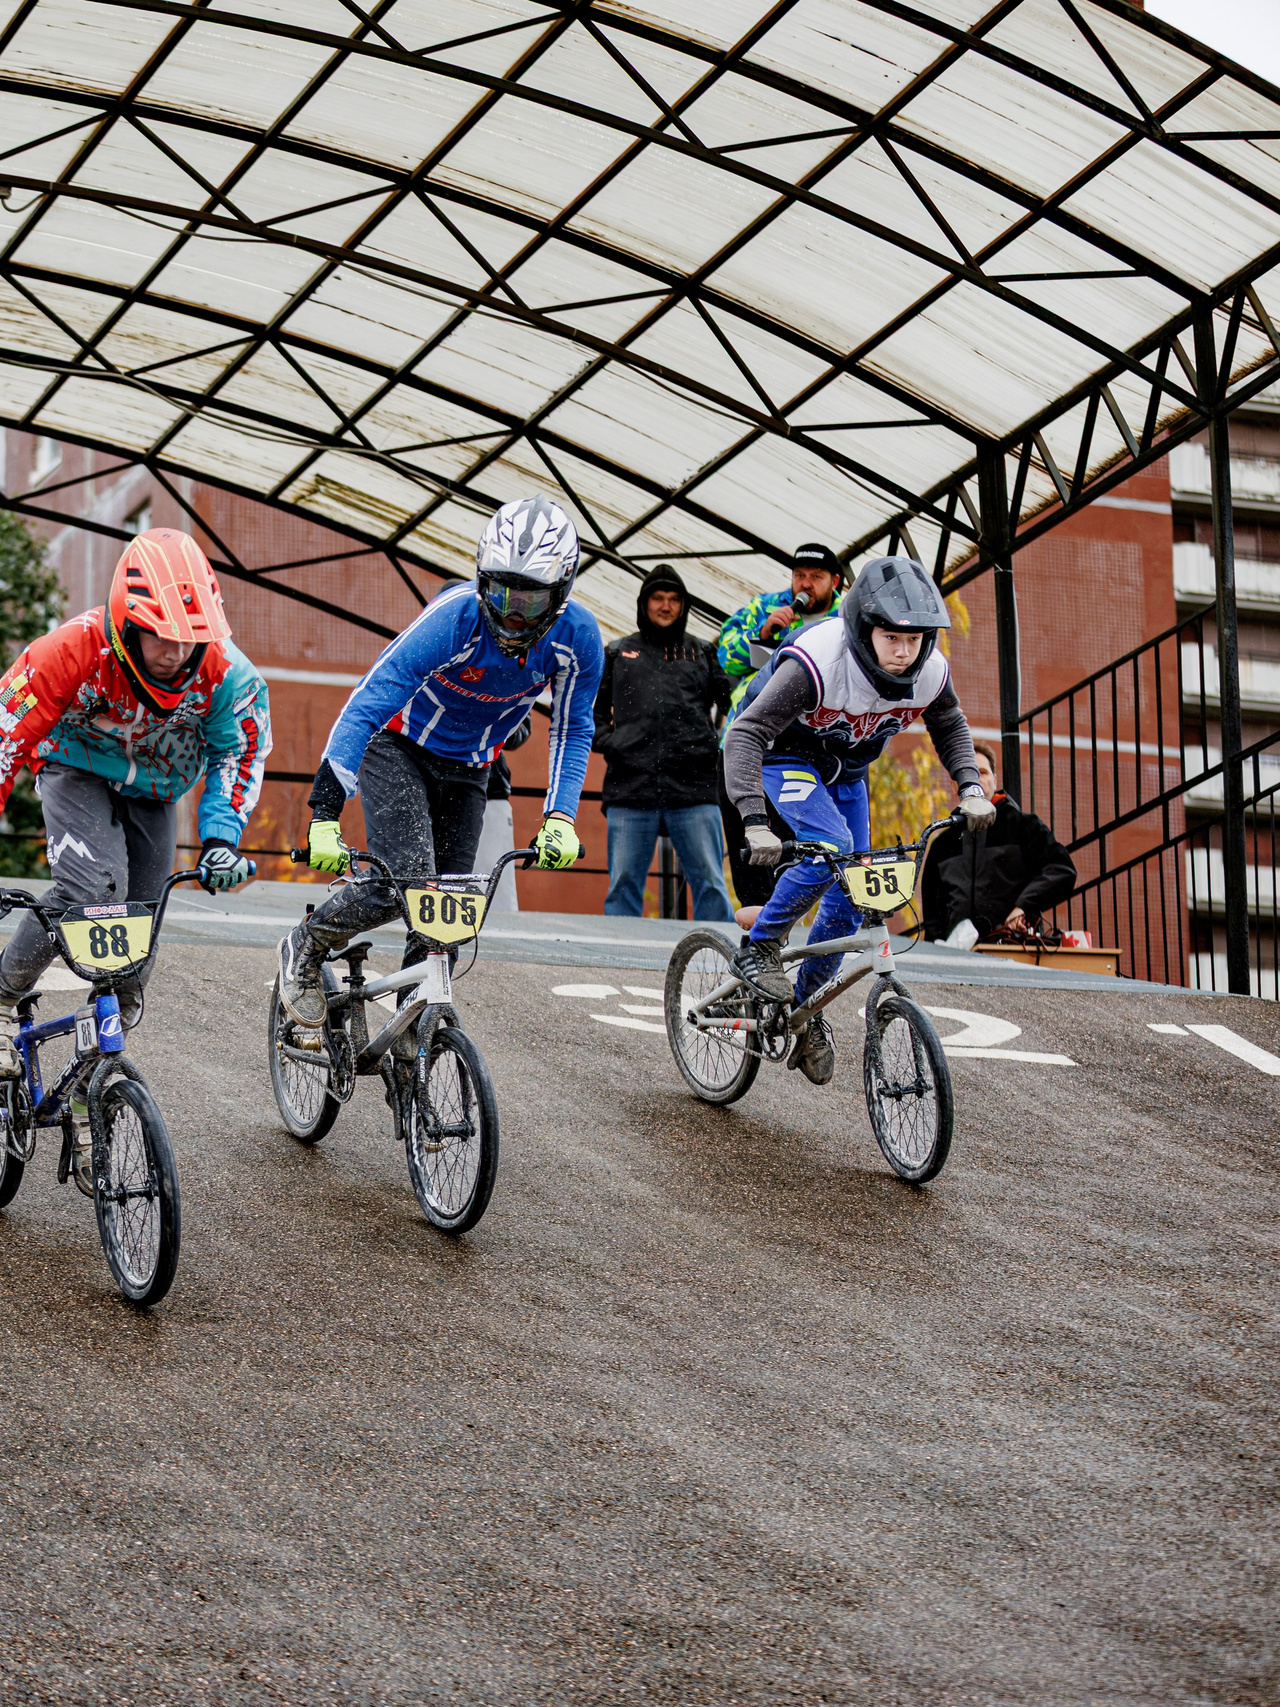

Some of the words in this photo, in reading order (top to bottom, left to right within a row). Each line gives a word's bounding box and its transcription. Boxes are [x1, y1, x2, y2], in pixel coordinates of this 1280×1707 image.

[864, 867, 898, 897] 55
[418, 894, 477, 926] 805
[88, 924, 130, 959] 88
[81, 1021, 94, 1047] 88
